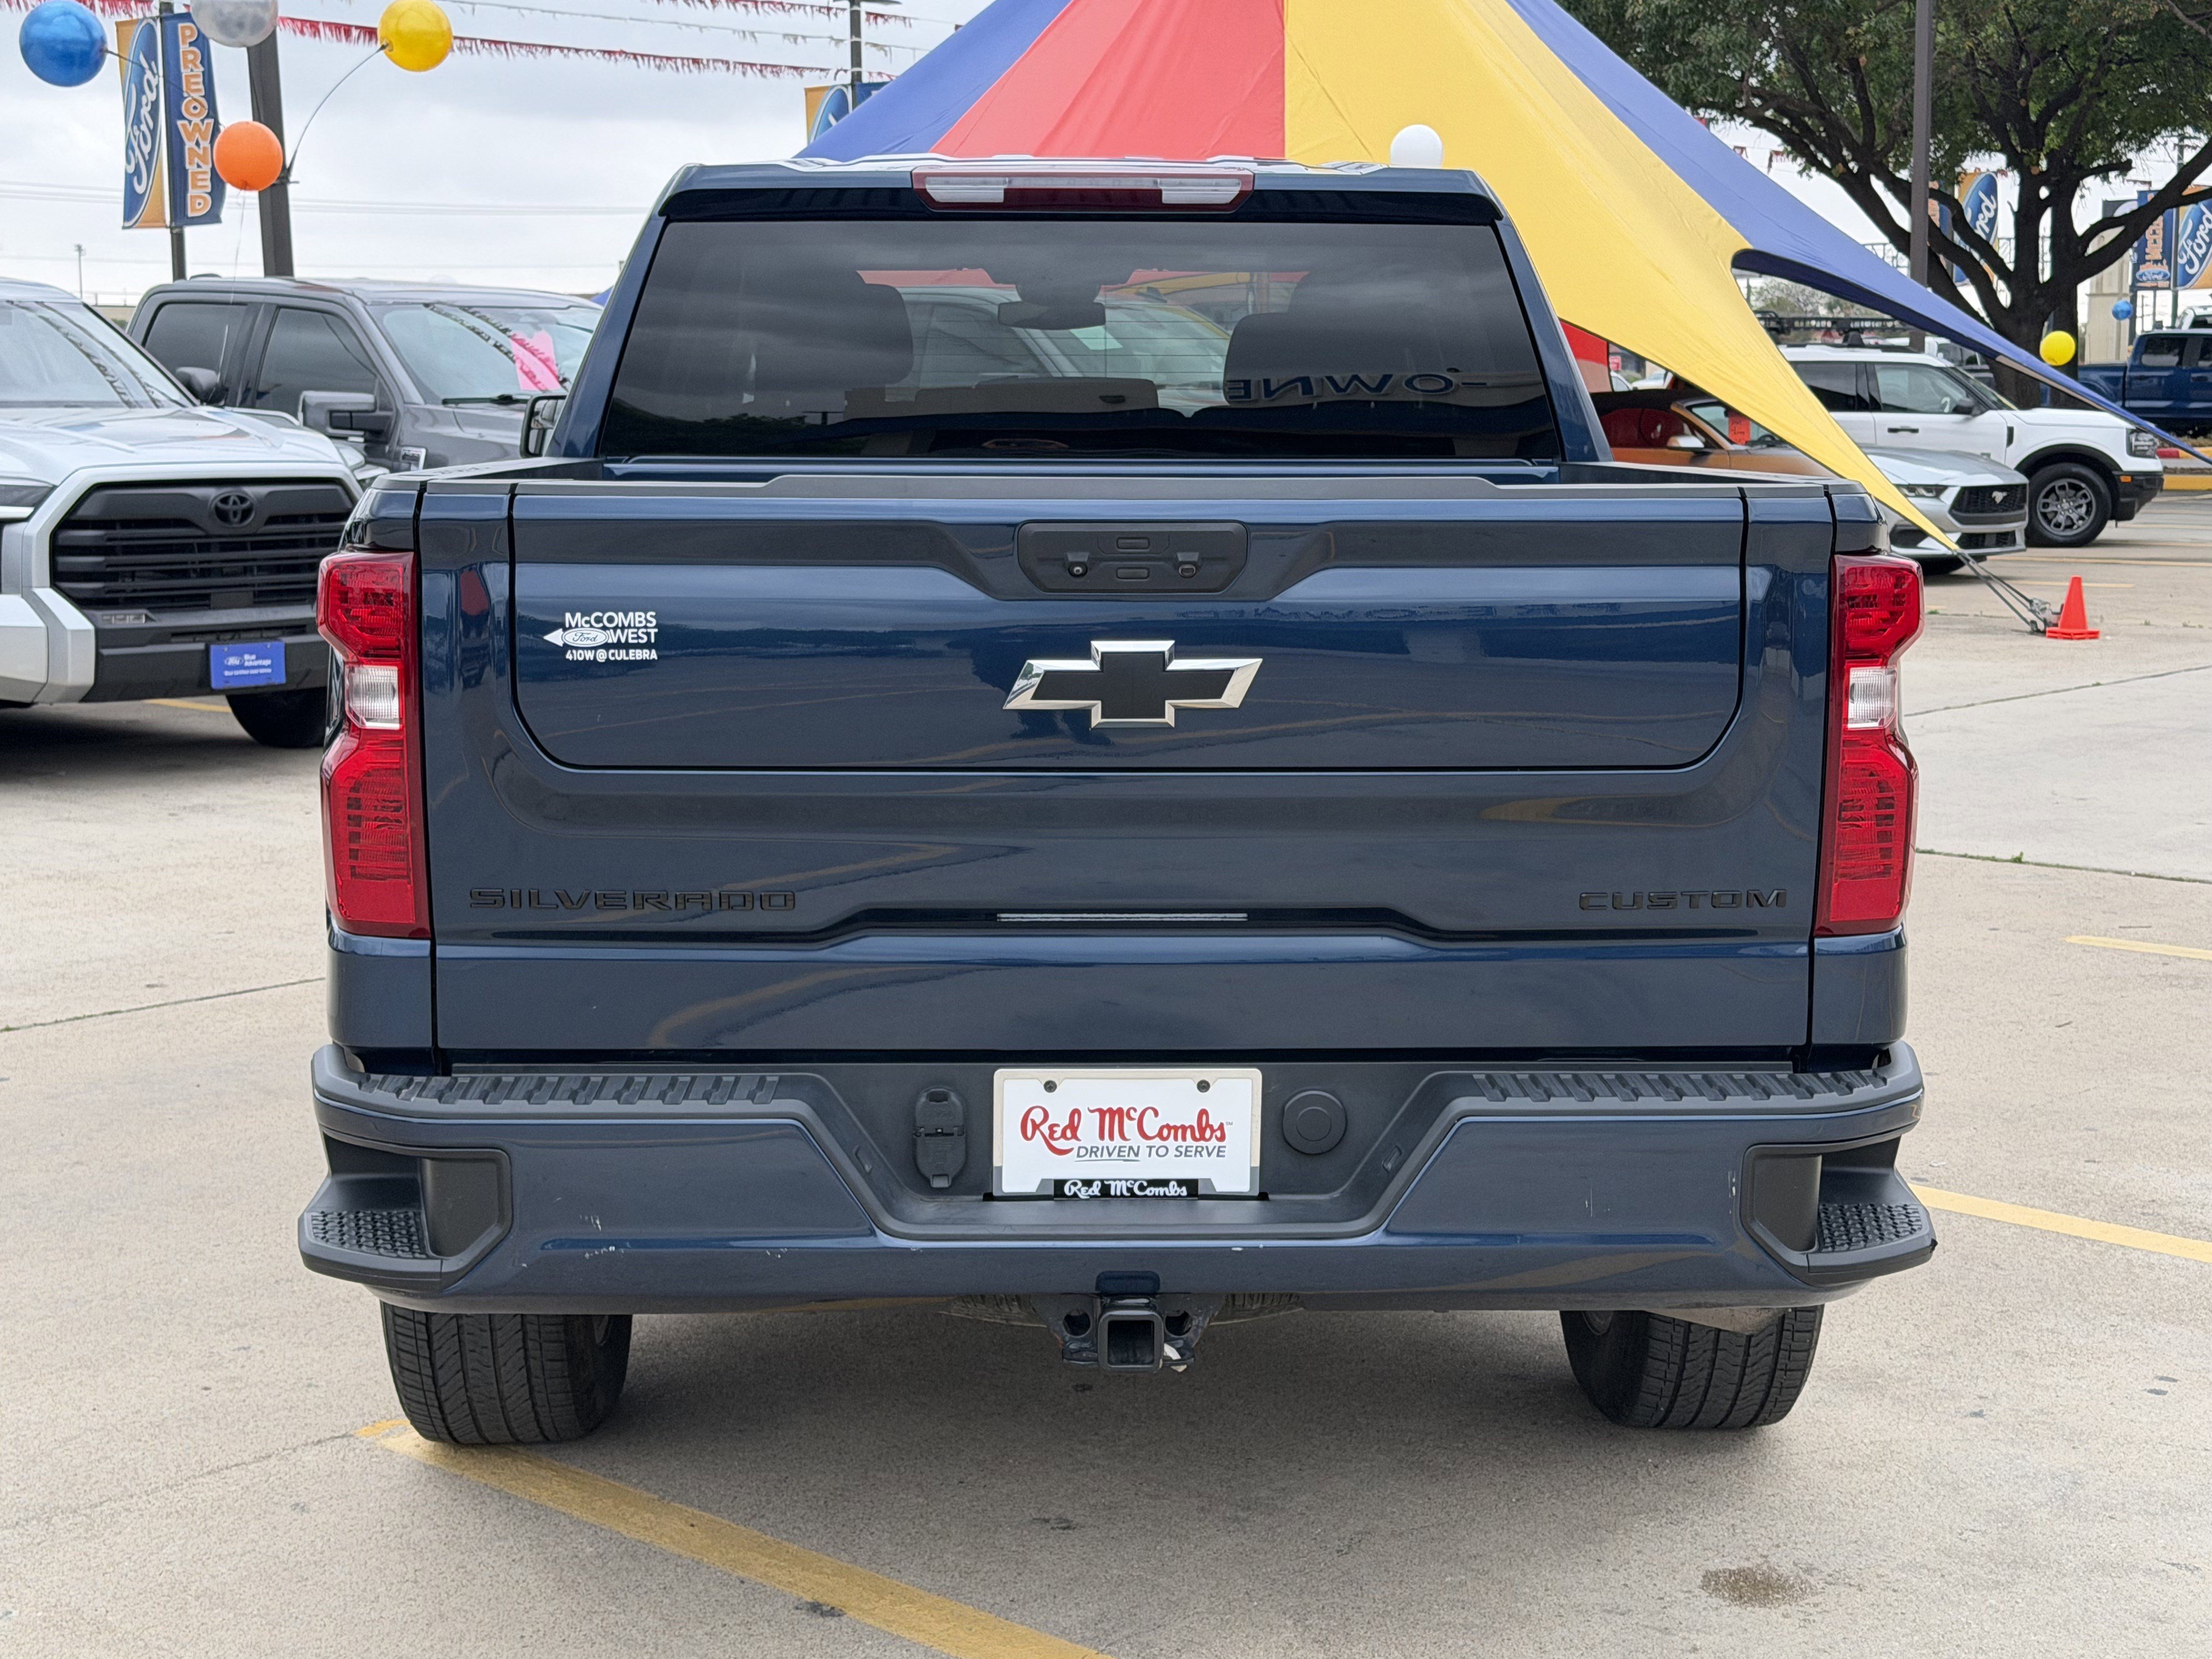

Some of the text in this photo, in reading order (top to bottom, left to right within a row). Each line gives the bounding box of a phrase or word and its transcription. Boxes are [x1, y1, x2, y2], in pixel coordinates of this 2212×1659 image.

[126, 50, 159, 194] Ford
[177, 22, 214, 217] PREOWNED
[565, 612, 656, 628] McCOMBS
[572, 629, 658, 643] Ford WEST
[470, 888, 796, 911] SILVERADO
[1579, 888, 1787, 910] CUSTOM
[1020, 1105, 1082, 1156] Red
[1087, 1106, 1227, 1143] McCombs
[1076, 1145, 1227, 1158] DRIVEN TO SERVE
[1064, 1180, 1188, 1199] Red McCombs
